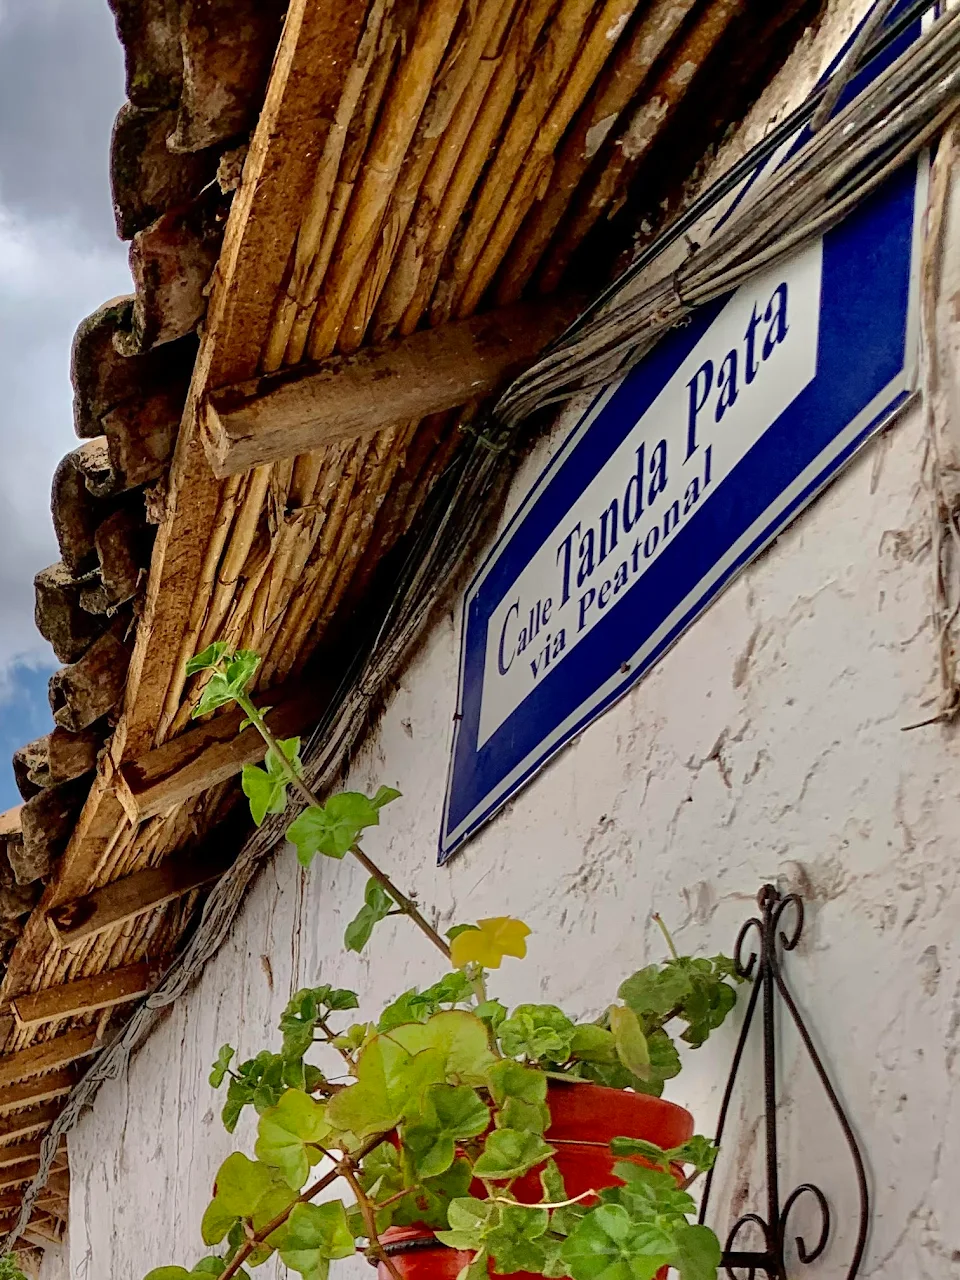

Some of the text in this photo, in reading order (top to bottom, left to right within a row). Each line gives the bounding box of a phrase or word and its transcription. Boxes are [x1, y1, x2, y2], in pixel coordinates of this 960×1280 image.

[497, 281, 790, 676] Calle Tanda Pata
[530, 444, 713, 680] via Peatonal
